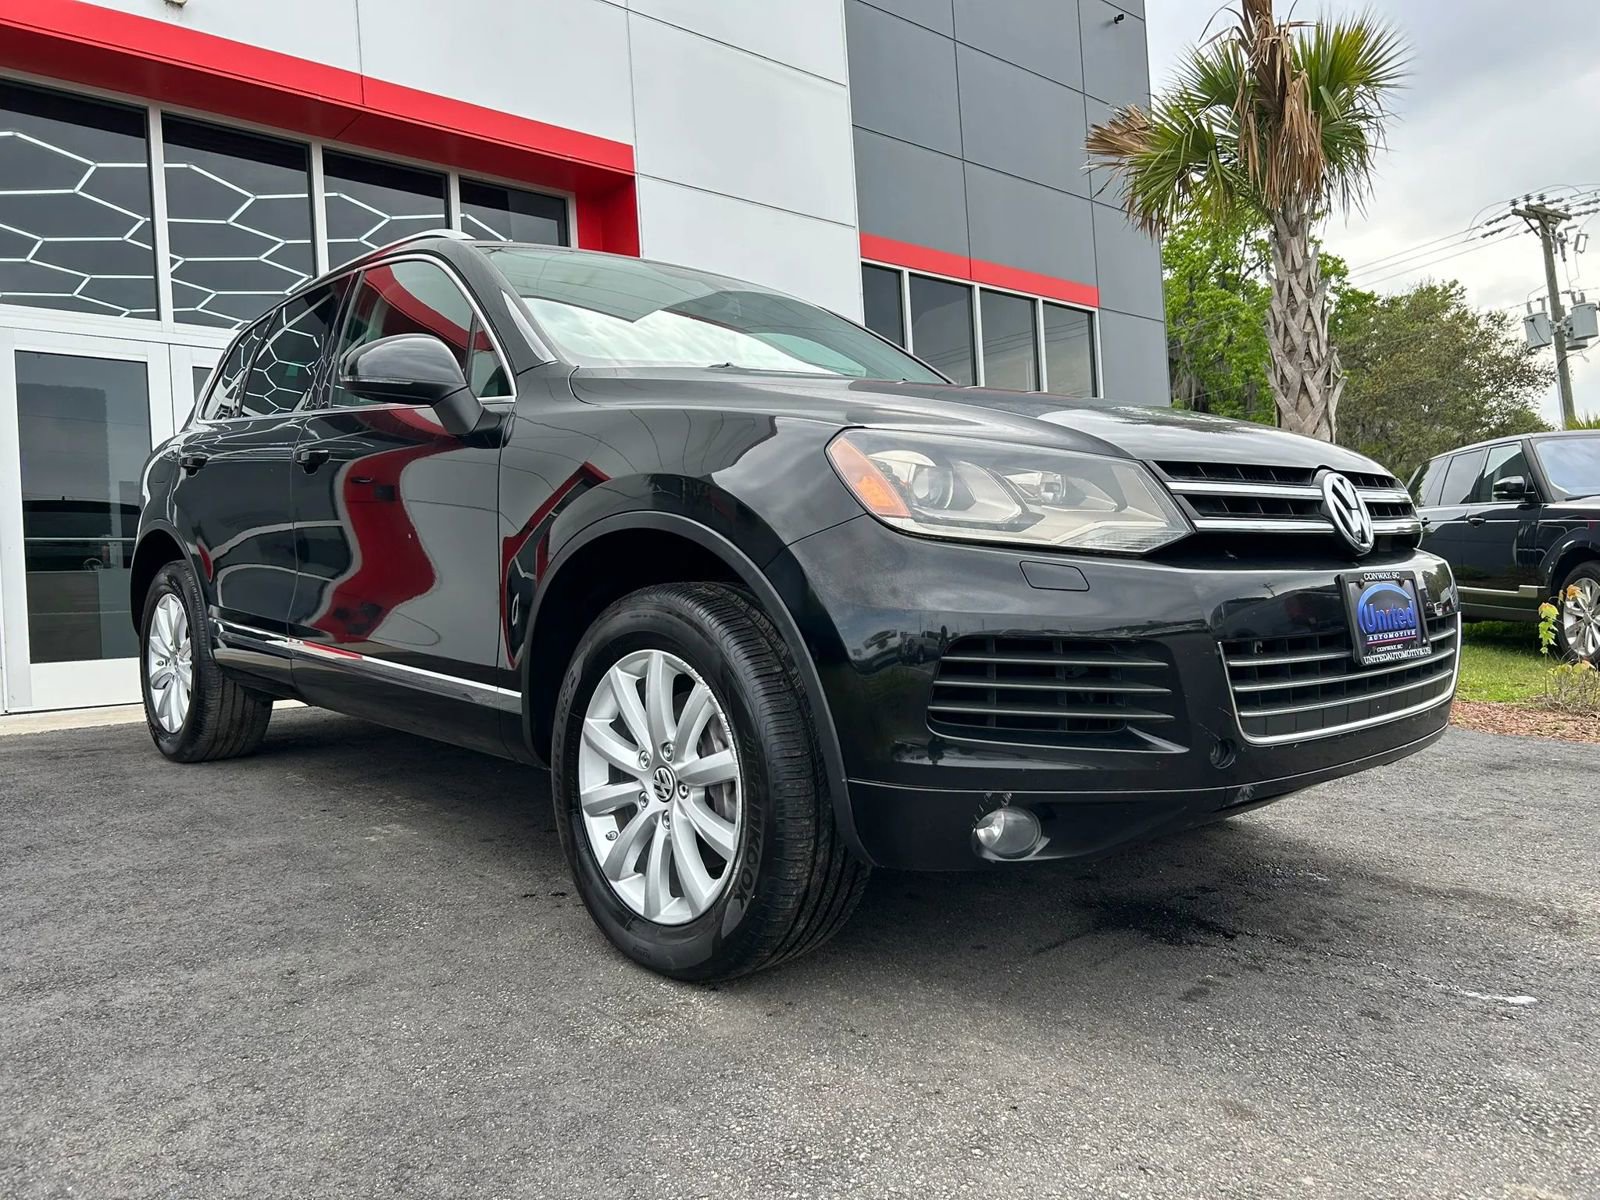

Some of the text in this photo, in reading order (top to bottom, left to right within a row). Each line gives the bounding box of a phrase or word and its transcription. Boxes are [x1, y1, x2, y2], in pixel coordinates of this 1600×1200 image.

[1391, 571, 1400, 579] SC
[1364, 600, 1416, 633] United
[1368, 629, 1416, 641] AUTOMOTIVE
